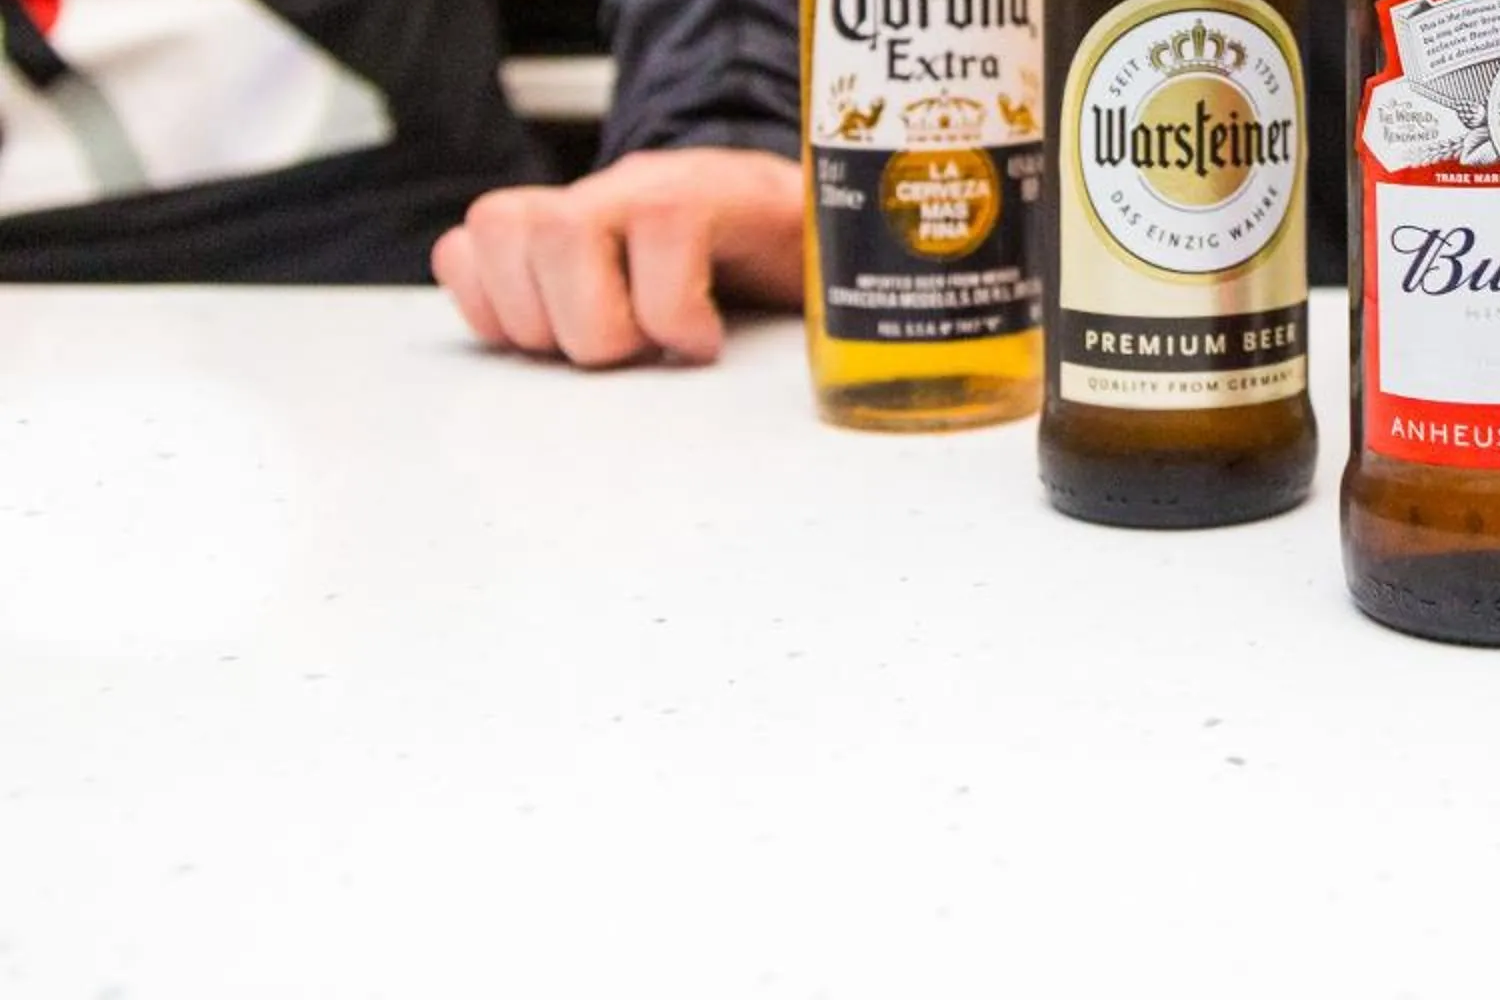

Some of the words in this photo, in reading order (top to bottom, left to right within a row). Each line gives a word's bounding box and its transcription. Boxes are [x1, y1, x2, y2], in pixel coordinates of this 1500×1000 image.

[886, 37, 1000, 82] Extra
[1109, 57, 1142, 98] SEIT
[1254, 57, 1281, 96] 1753
[1091, 98, 1294, 180] Warsteiner
[928, 160, 960, 179] LA
[1435, 173, 1471, 184] TRADE
[896, 178, 991, 202] CERVEZA
[919, 202, 969, 220] MAS
[1110, 189, 1143, 226] DAS
[1146, 224, 1221, 250] EINZIG
[1228, 184, 1280, 242] WAHRE
[919, 221, 970, 241] FINA
[1085, 329, 1227, 357] PREMIUM
[1243, 322, 1298, 352] BEER
[1087, 376, 1159, 393] QUALITY
[1167, 380, 1219, 394] FROM
